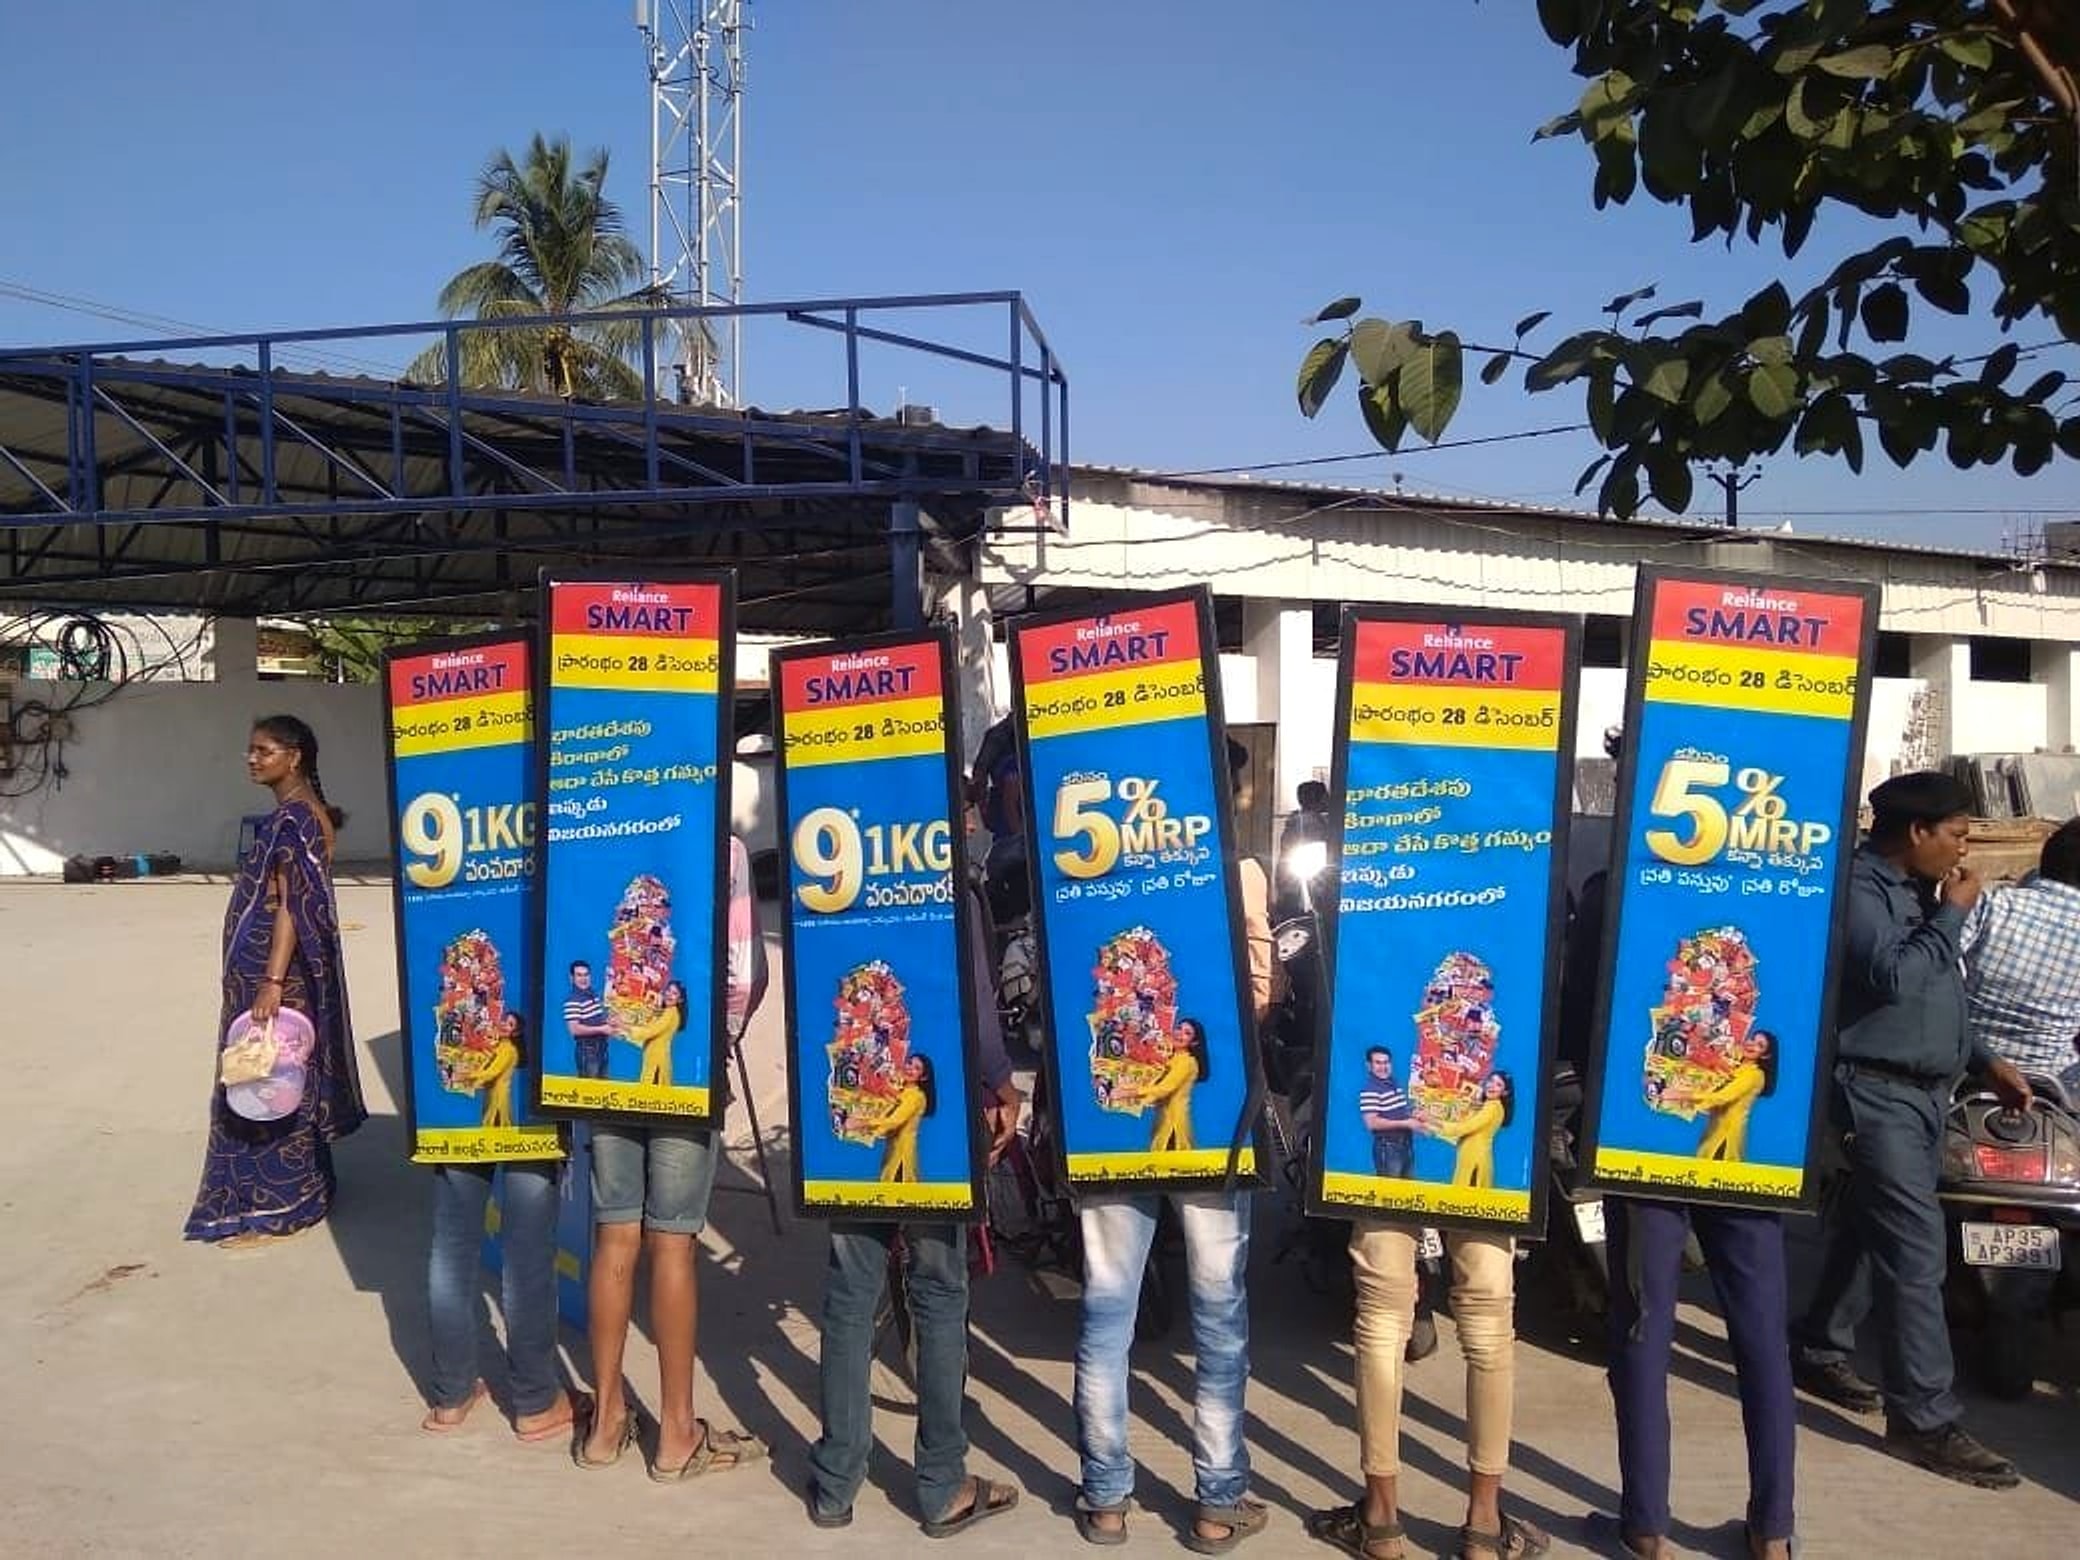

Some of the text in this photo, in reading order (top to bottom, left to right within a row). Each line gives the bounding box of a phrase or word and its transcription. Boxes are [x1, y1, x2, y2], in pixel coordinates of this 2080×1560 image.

[612, 588, 669, 603] Reliance
[1722, 591, 1798, 612] Reliance
[587, 605, 692, 632] SMART
[1686, 608, 1829, 647] SMART
[1076, 620, 1140, 642] Reliance
[1423, 630, 1494, 651] Reliance
[432, 652, 484, 669] Reliance
[628, 656, 647, 671] 28
[831, 654, 890, 673] Reliance
[1050, 631, 1169, 675] SMART
[1391, 650, 1523, 682] SMART
[412, 664, 506, 699] SMART
[805, 666, 915, 703] SMART
[1740, 670, 1765, 688] 28
[1103, 690, 1126, 708] 28
[453, 716, 471, 732] 28
[1441, 707, 1466, 726] 28
[854, 724, 874, 741] 28
[1120, 815, 1211, 855] MRP
[1729, 815, 1831, 855] MRP
[864, 820, 952, 875] 1KG
